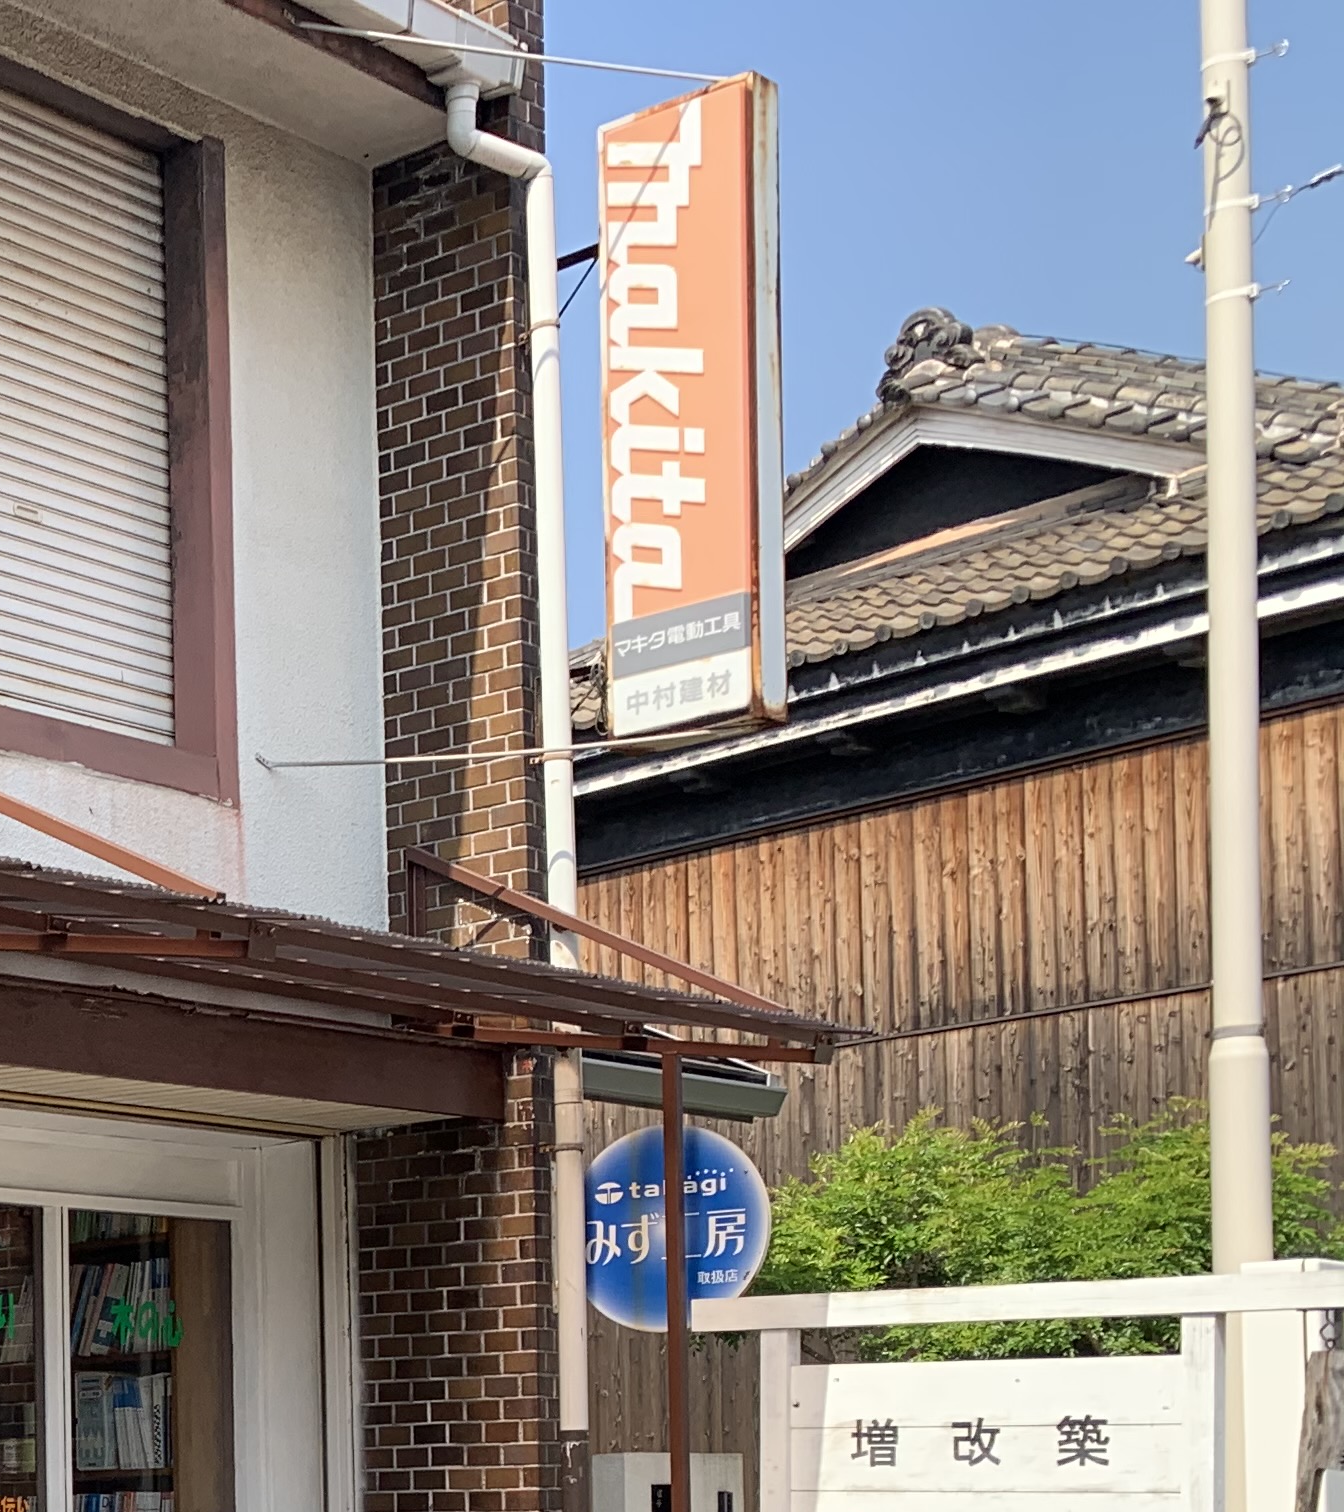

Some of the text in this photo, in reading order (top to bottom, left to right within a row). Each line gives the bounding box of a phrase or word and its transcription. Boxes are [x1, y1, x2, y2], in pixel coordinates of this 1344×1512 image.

[607, 97, 705, 626] makita
[614, 610, 742, 658] マキタ電動工具
[626, 669, 732, 716] 中村建材
[629, 1173, 727, 1199] taagi
[697, 1269, 739, 1285] 取扱店
[850, 1414, 1111, 1468] 増改築
